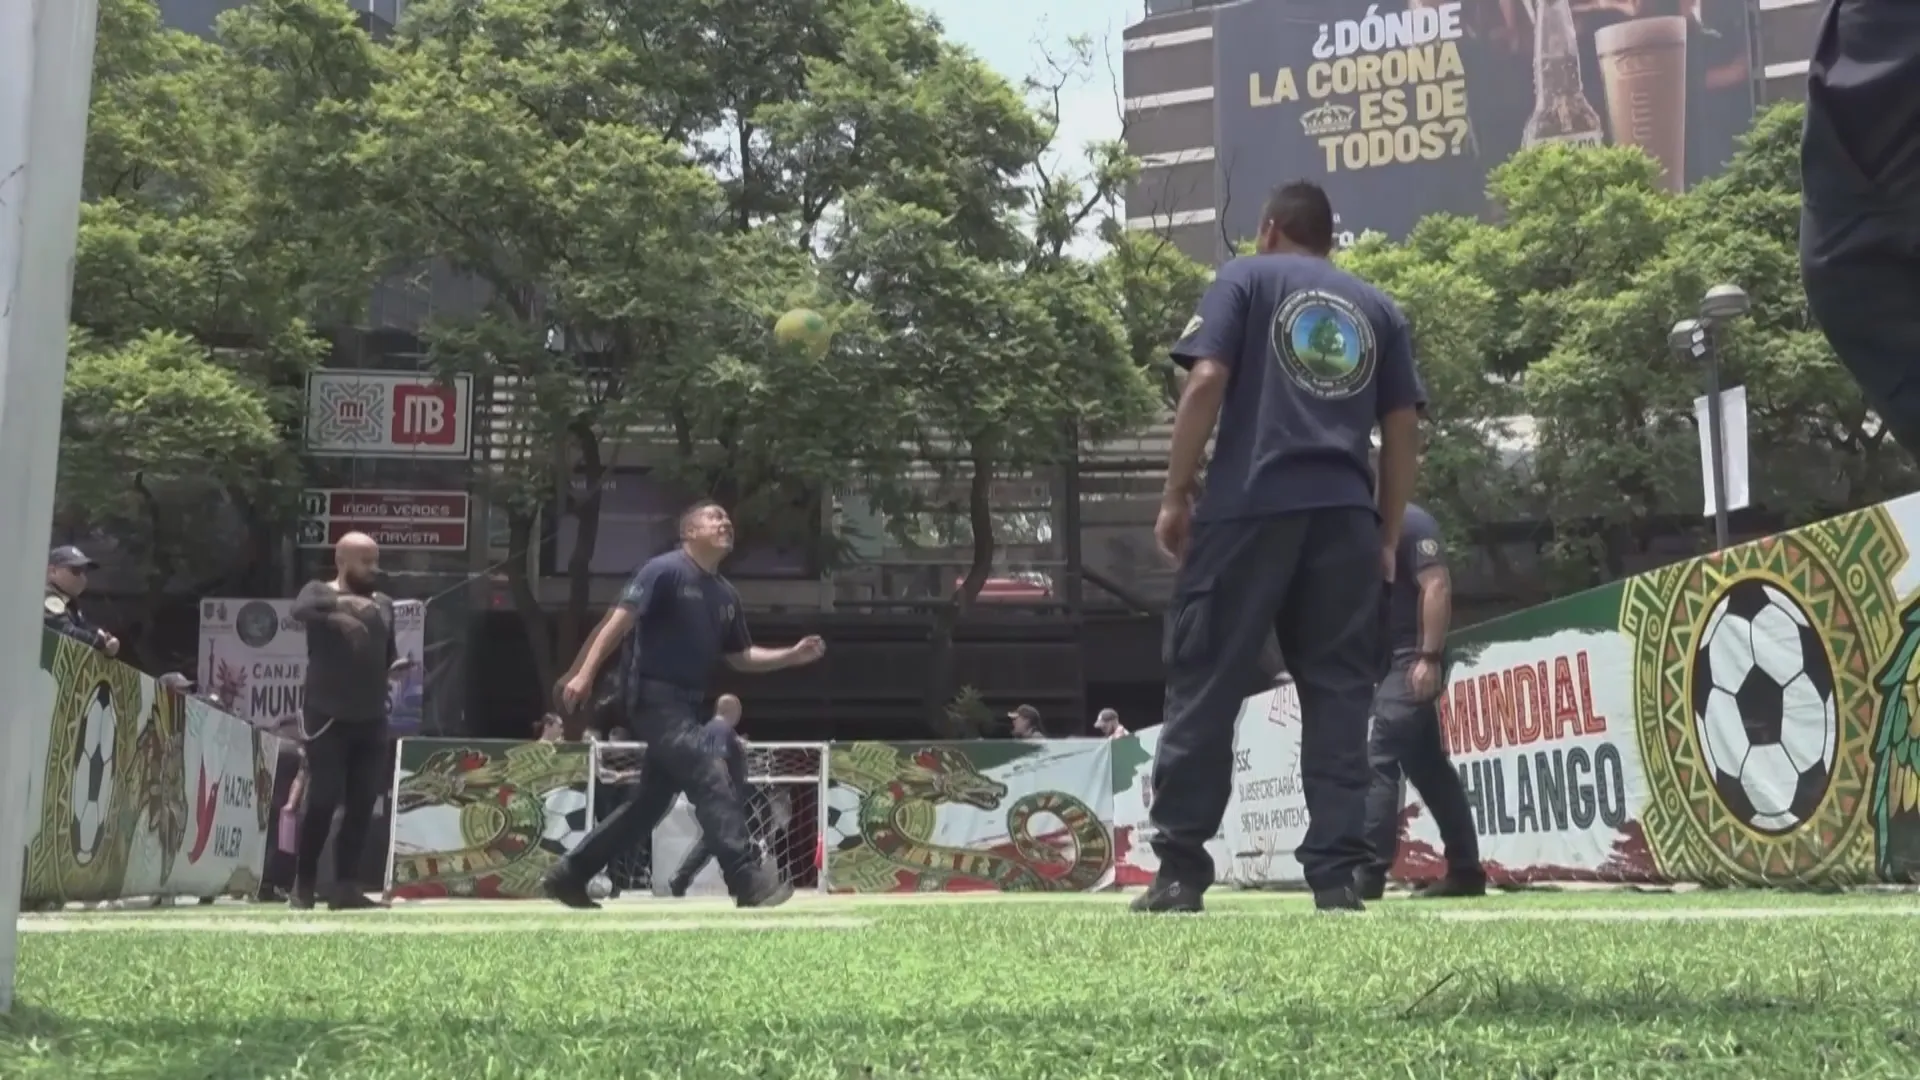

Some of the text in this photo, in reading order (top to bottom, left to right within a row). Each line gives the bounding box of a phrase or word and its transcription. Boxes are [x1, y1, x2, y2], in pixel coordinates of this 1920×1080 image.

[1312, 3, 1463, 59] ¿DÓNDE
[1249, 41, 1464, 107] LA CORONA
[1359, 79, 1467, 131] ES DE
[1318, 119, 1468, 173] TODOS?
[403, 395, 445, 434] MB
[343, 504, 450, 517] INDIOS VERDES
[367, 531, 439, 544] ENAVISTA
[253, 663, 301, 679] CANJE
[1439, 649, 1606, 755] MUNDIAL
[1458, 742, 1626, 835] HILANGO
[1271, 805, 1308, 829] PENITENC
[214, 823, 242, 857] VALER
